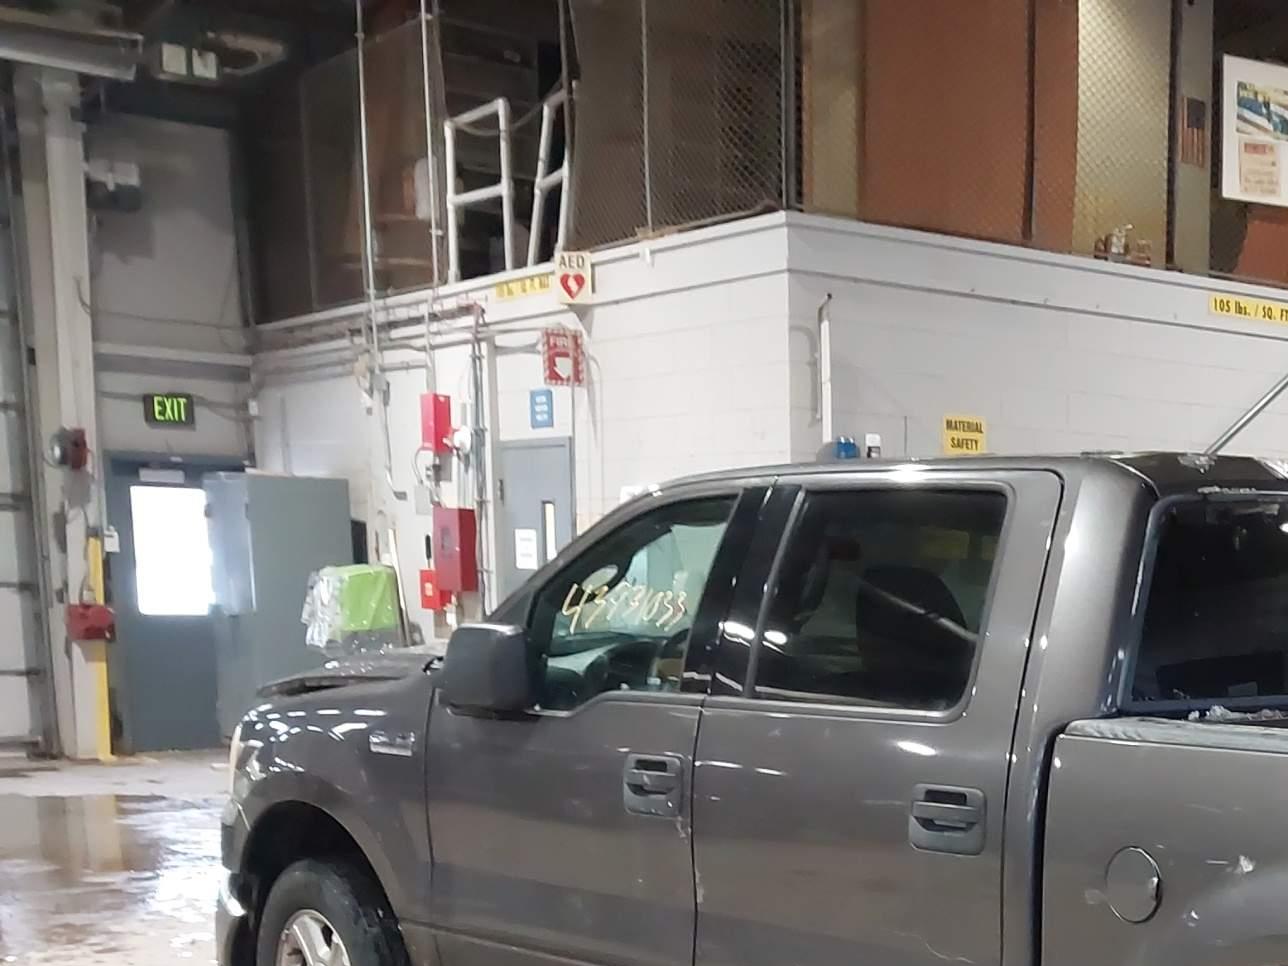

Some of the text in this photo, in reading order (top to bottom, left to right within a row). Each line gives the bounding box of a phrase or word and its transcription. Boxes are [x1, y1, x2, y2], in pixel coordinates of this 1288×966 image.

[558, 254, 585, 269] AED
[1214, 298, 1231, 313] 105
[1234, 300, 1251, 316] lbs.
[1262, 305, 1277, 320] SQ.
[153, 396, 187, 421] EXIT
[945, 419, 984, 434] MATERIAL
[950, 436, 978, 451] SAFETY
